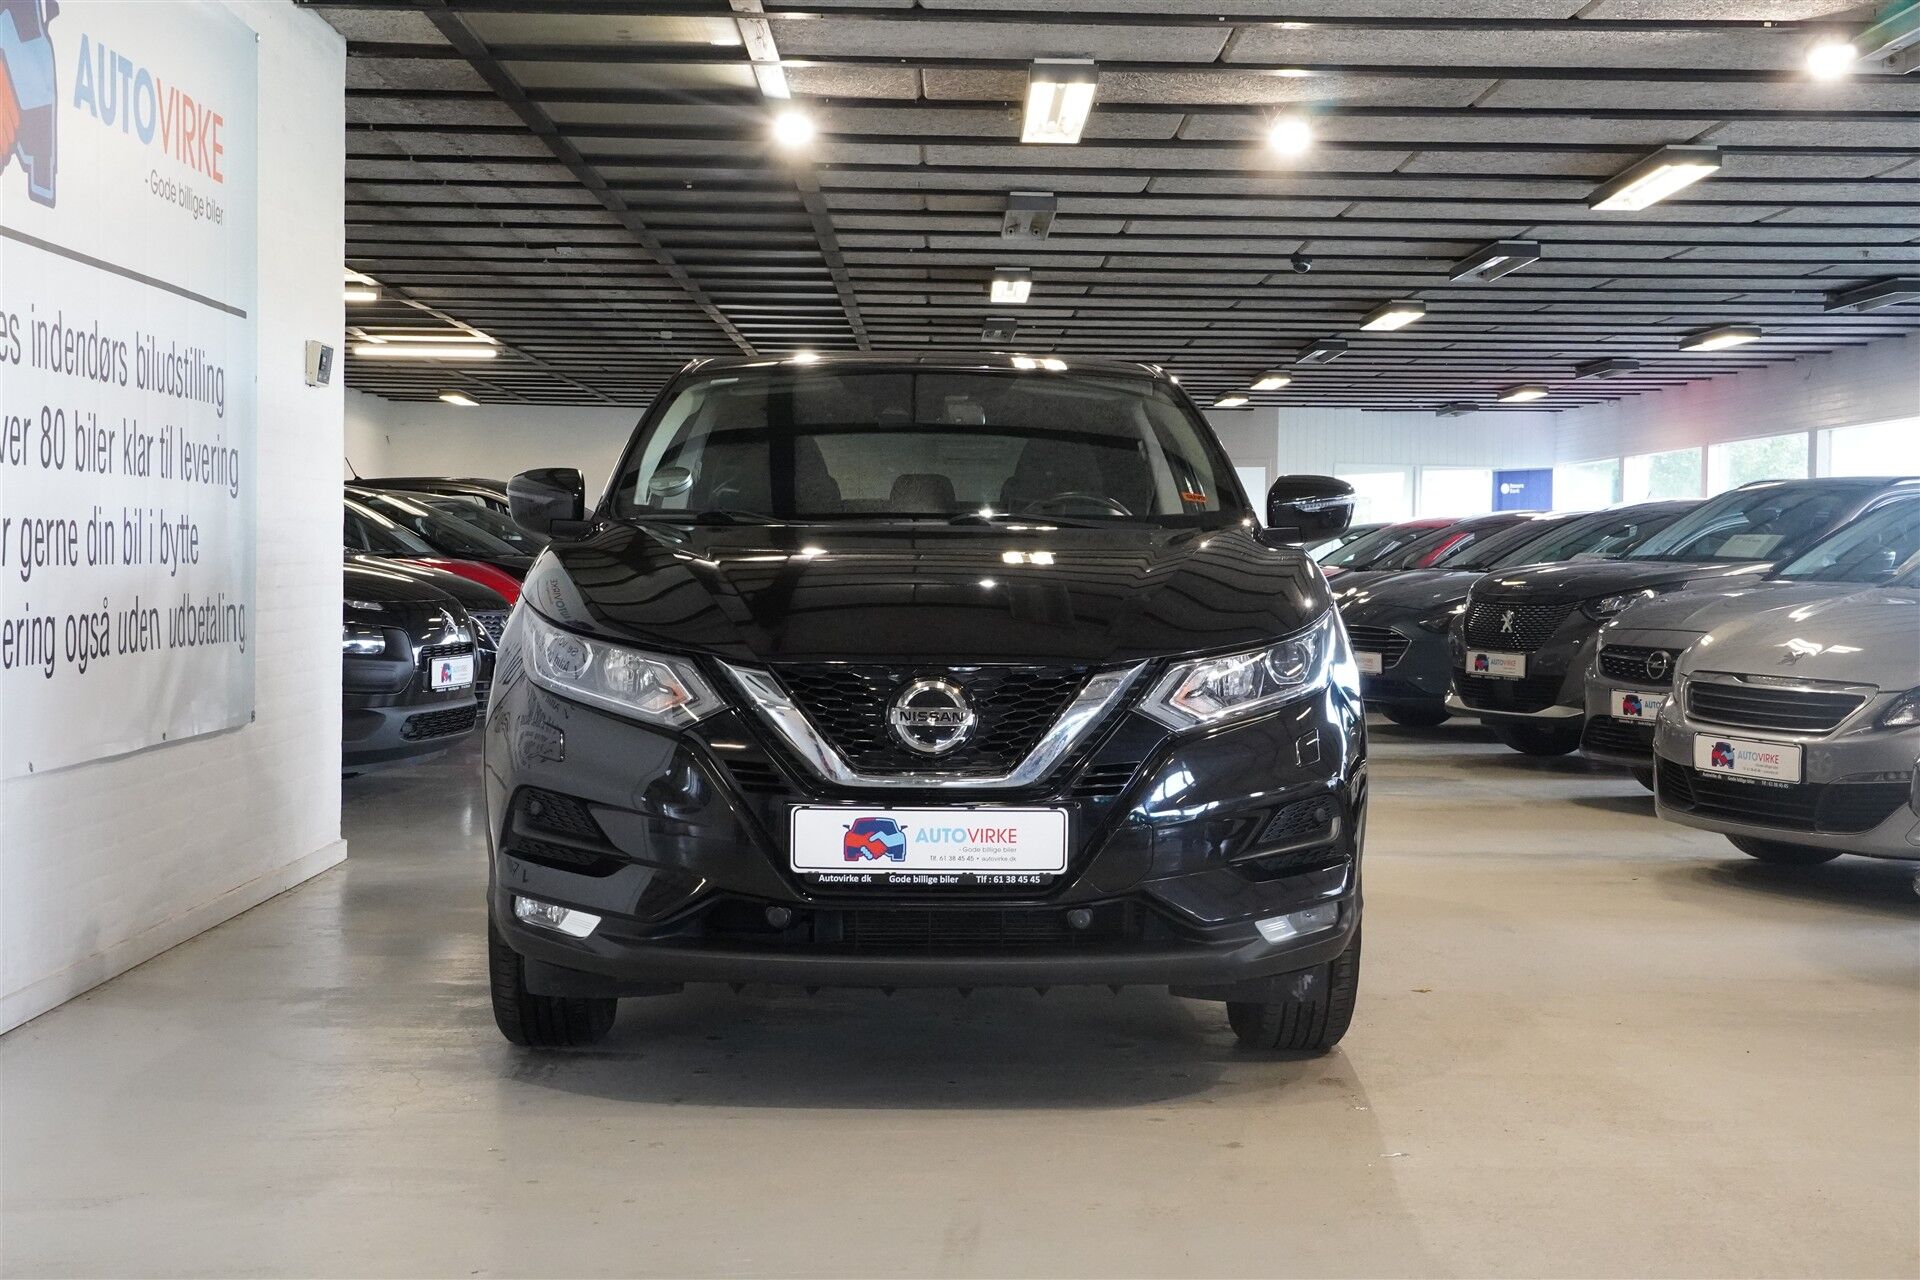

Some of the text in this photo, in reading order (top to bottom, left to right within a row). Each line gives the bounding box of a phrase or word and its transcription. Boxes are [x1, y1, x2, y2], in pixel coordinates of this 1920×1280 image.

[73, 33, 224, 184] AUTOVIRKE
[150, 169, 177, 204] Gode
[178, 182, 204, 220] billige
[206, 199, 224, 226] biler
[31, 303, 128, 387] indendørs
[136, 331, 224, 418] biludstilling
[40, 405, 65, 470] 80
[75, 410, 115, 474] biler
[123, 417, 154, 477] klar
[159, 425, 173, 479] til
[180, 427, 239, 499] levering
[20, 517, 78, 582] gerne
[87, 505, 114, 566] din
[123, 506, 142, 566] bil
[149, 508, 153, 564] i
[160, 508, 199, 577] bytte
[2, 592, 247, 679] ering også uden udbetaling
[900, 711, 964, 722] NISSAN
[1737, 750, 1780, 764] AUTOVIRKE
[915, 828, 1017, 844] AUTOVIRKE
[818, 874, 860, 883] Autovirke
[889, 874, 959, 885] Gode billige biler
[993, 875, 1003, 884] 61
[1005, 875, 1016, 884] 38
[1018, 875, 1029, 884] 45
[1030, 875, 1041, 884] 45
